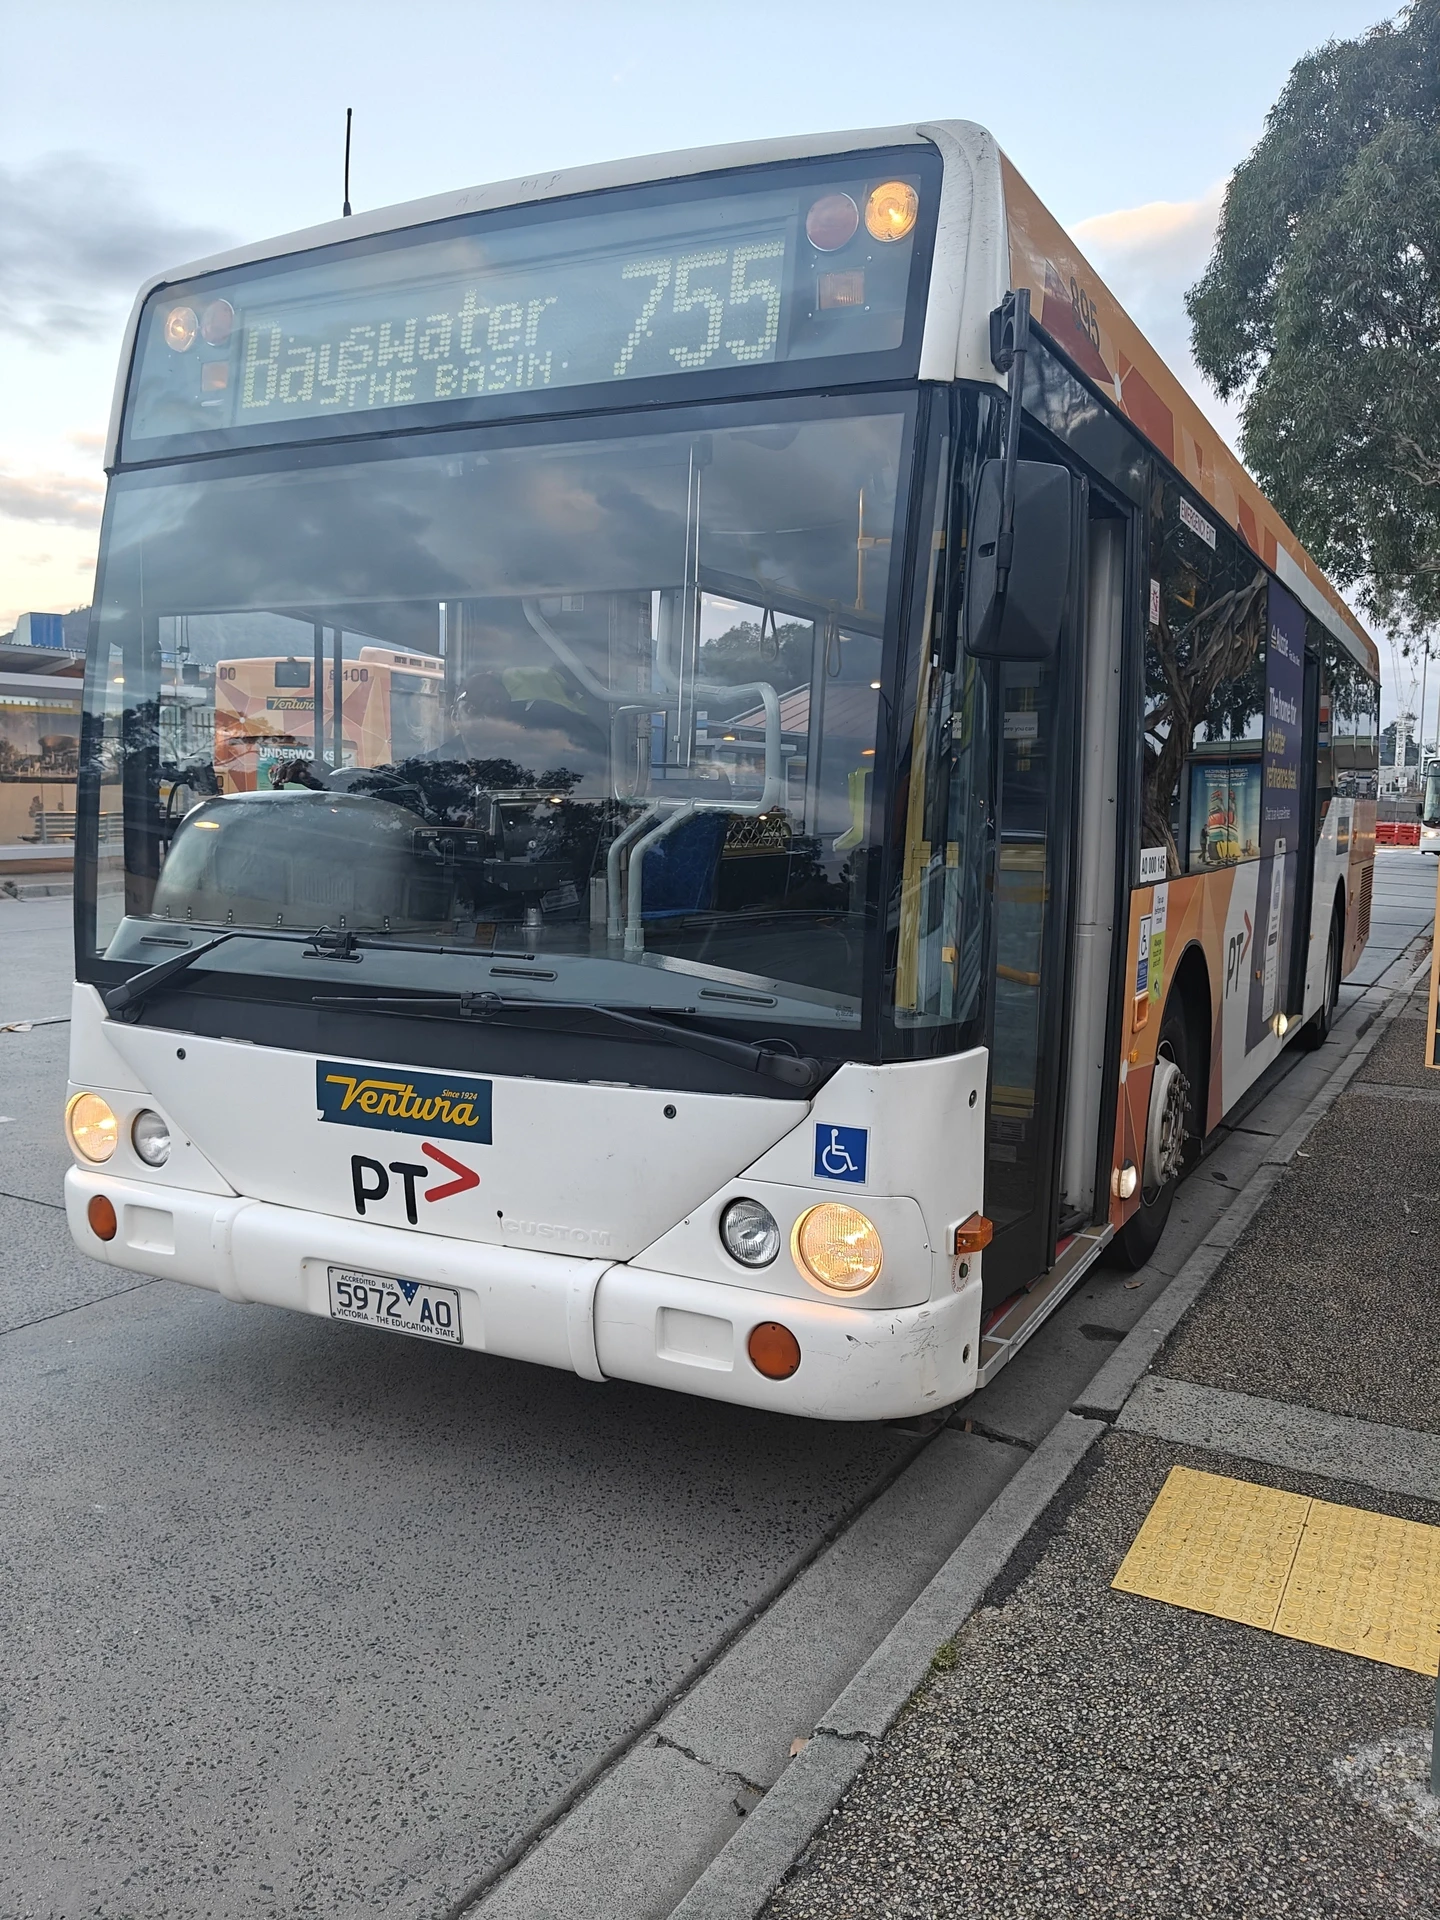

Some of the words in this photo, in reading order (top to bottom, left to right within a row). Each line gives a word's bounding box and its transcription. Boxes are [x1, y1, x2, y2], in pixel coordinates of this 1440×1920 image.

[613, 241, 786, 377] 755
[1070, 276, 1100, 354] 895
[243, 289, 558, 409] Bayswater
[347, 367, 418, 407] THE
[1269, 686, 1279, 719] The
[1278, 690, 1291, 724] home
[259, 747, 335, 761] UNDERWOKS
[1148, 856, 1157, 874] 000
[1226, 932, 1244, 1000] PT
[325, 1075, 480, 1127] Ventura
[442, 1089, 460, 1099] Since
[460, 1091, 478, 1101] 1924
[502, 1218, 612, 1246] CUSTOM
[340, 1274, 376, 1287] ACCREDITED
[381, 1281, 395, 1290] BUS
[336, 1281, 402, 1318] 5972
[420, 1298, 451, 1328] AO
[336, 1307, 369, 1321] VICTORIA
[376, 1315, 390, 1325] THE
[391, 1319, 433, 1334] EDUCATION
[435, 1327, 455, 1338] STATE
